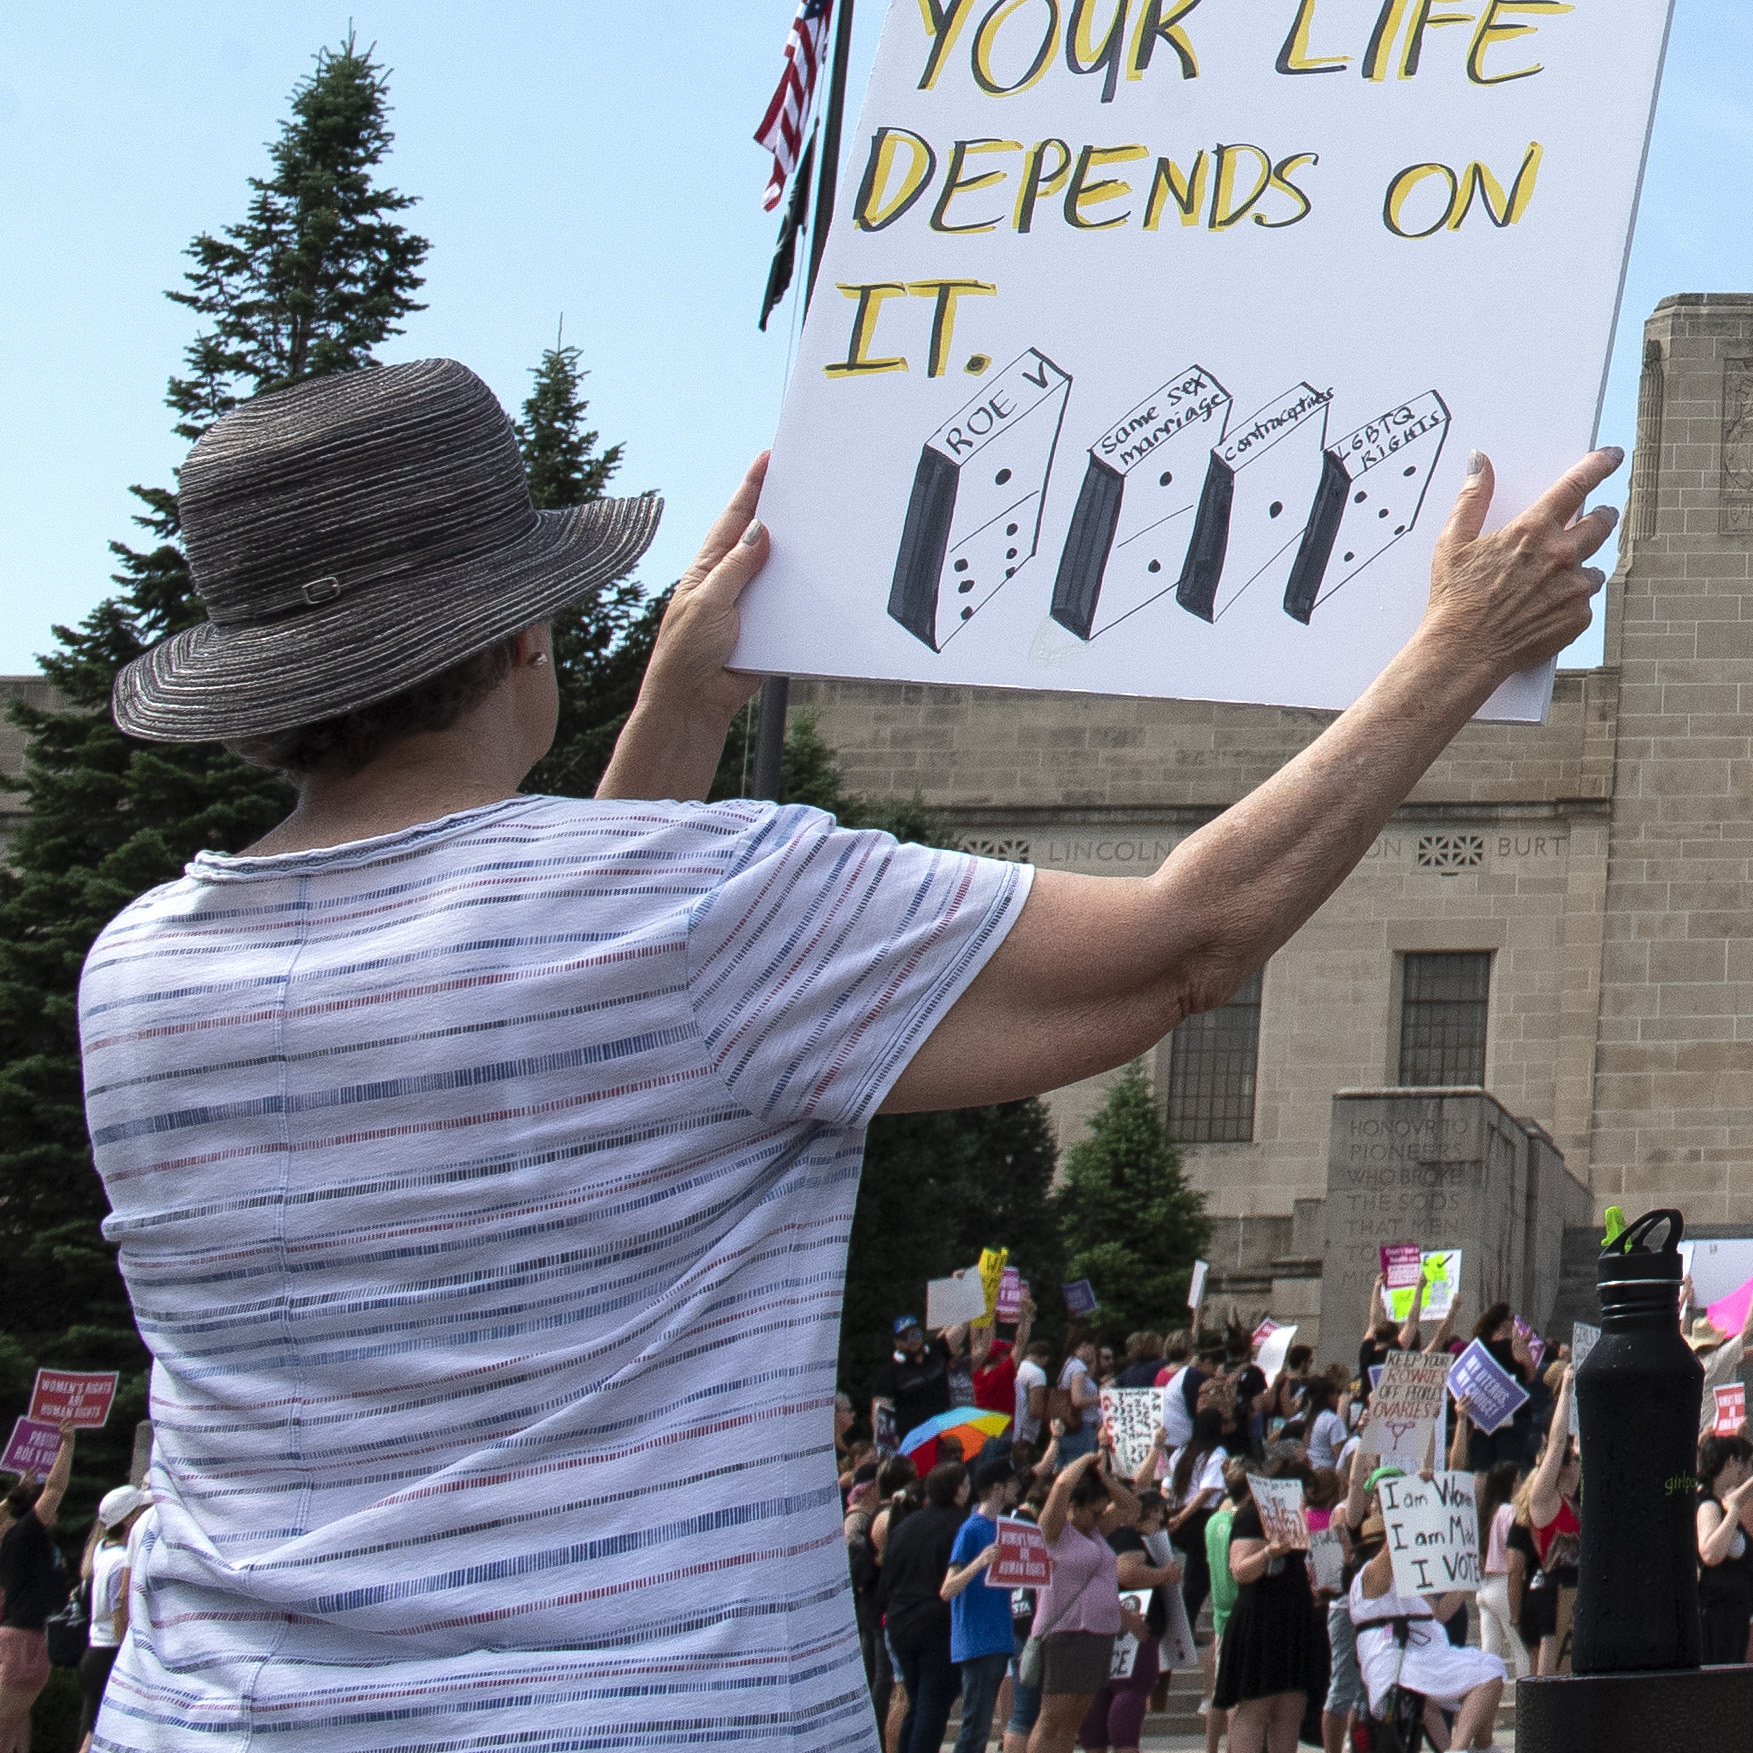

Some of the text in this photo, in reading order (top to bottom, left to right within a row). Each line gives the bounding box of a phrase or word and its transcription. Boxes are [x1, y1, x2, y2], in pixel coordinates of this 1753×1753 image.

[853, 126, 1545, 241] DEPENDS ON
[824, 276, 998, 381] IT.
[945, 389, 1017, 457] ROE
[1119, 393, 1222, 466] marriage
[1336, 406, 1414, 462] LGBTQ
[1498, 836, 1568, 858] BURT
[1387, 1353, 1418, 1368] KEEP
[1464, 1355, 1483, 1375] MY
[1455, 1368, 1472, 1389] MY
[1384, 1481, 1428, 1510] I am
[1391, 1523, 1409, 1550] I
[1414, 1530, 1446, 1547] am
[1410, 1558, 1434, 1589] I
